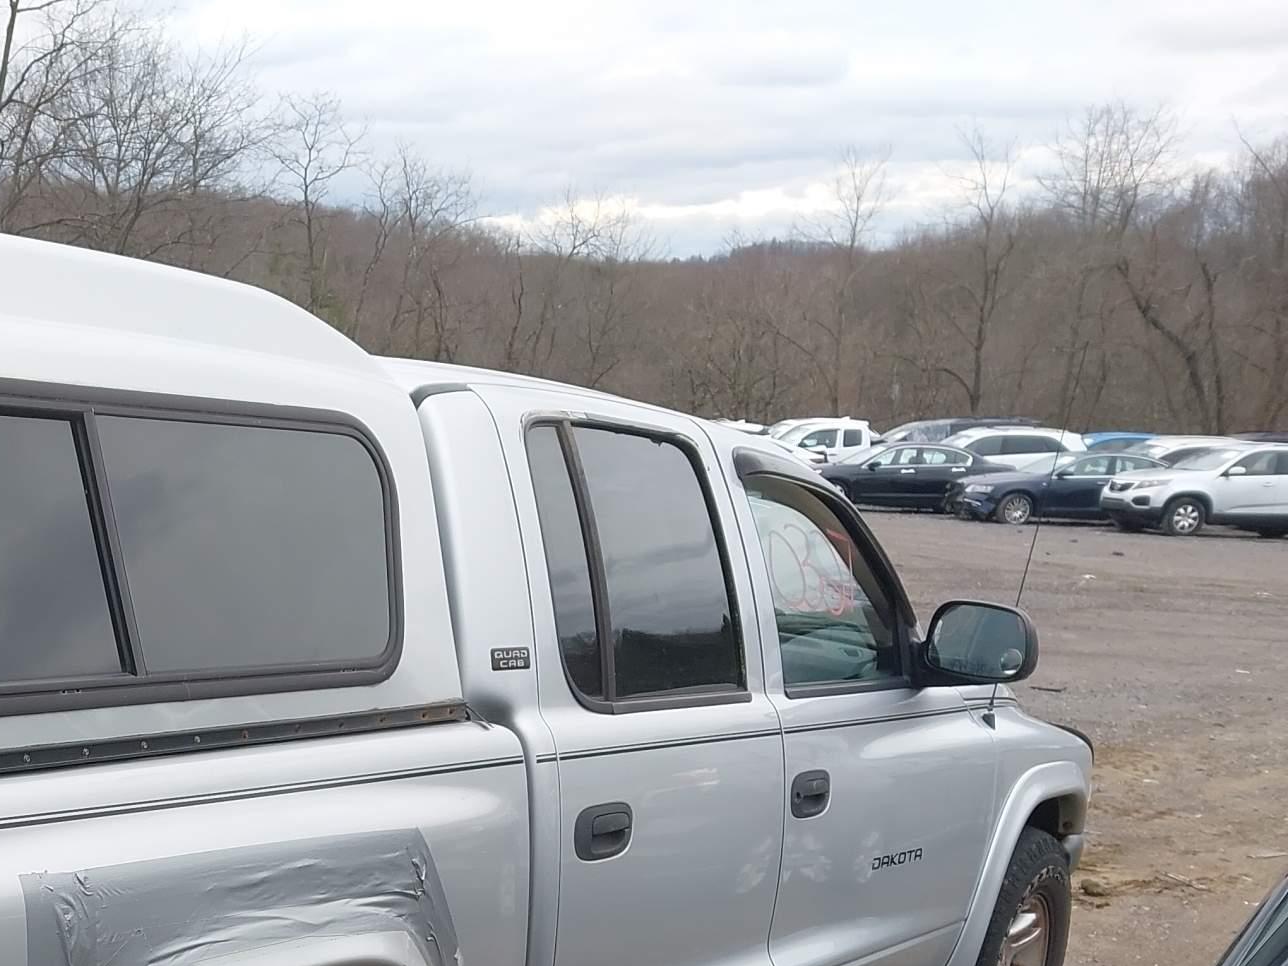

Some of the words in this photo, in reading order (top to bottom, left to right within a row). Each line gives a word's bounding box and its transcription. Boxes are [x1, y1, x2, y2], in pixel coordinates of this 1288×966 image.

[494, 649, 528, 660] QUAD
[499, 659, 525, 668] CAB
[871, 847, 923, 871] DAKOTA
